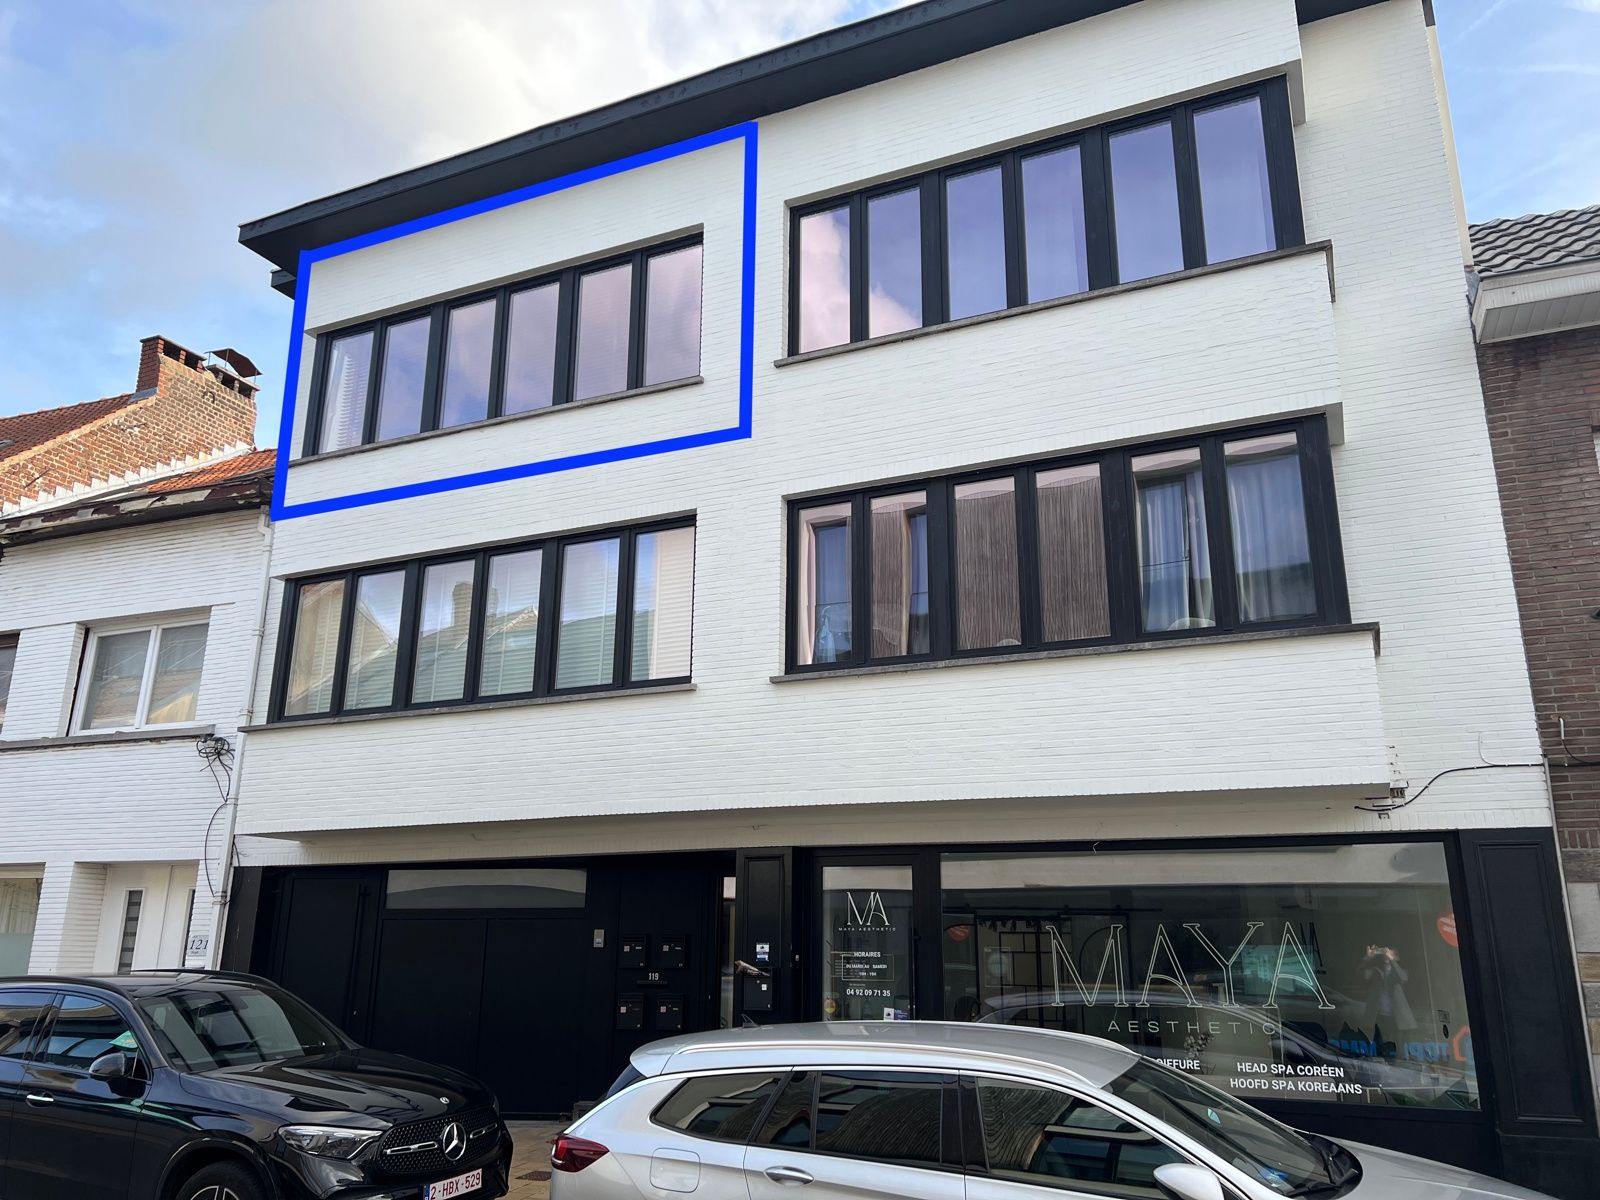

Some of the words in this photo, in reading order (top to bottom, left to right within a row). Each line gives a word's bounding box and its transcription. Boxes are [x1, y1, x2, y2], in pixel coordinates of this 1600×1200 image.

[190, 939, 209, 950] 121
[1046, 921, 1336, 1009] MAYA
[648, 972, 659, 981] 119
[846, 988, 854, 996] 04
[873, 989, 881, 997] 71
[882, 989, 891, 997] 35
[1107, 1020, 1278, 1035] AESTHETIC
[1237, 1062, 1268, 1074] HEAD
[1270, 1063, 1294, 1076] SPA
[1296, 1063, 1345, 1078] CORÉEN
[1230, 1078, 1269, 1090] HOOFD
[1271, 1080, 1294, 1091] SPA
[1298, 1081, 1363, 1095] KOREAANS
[430, 1172, 481, 1200] 2-HBX-529
